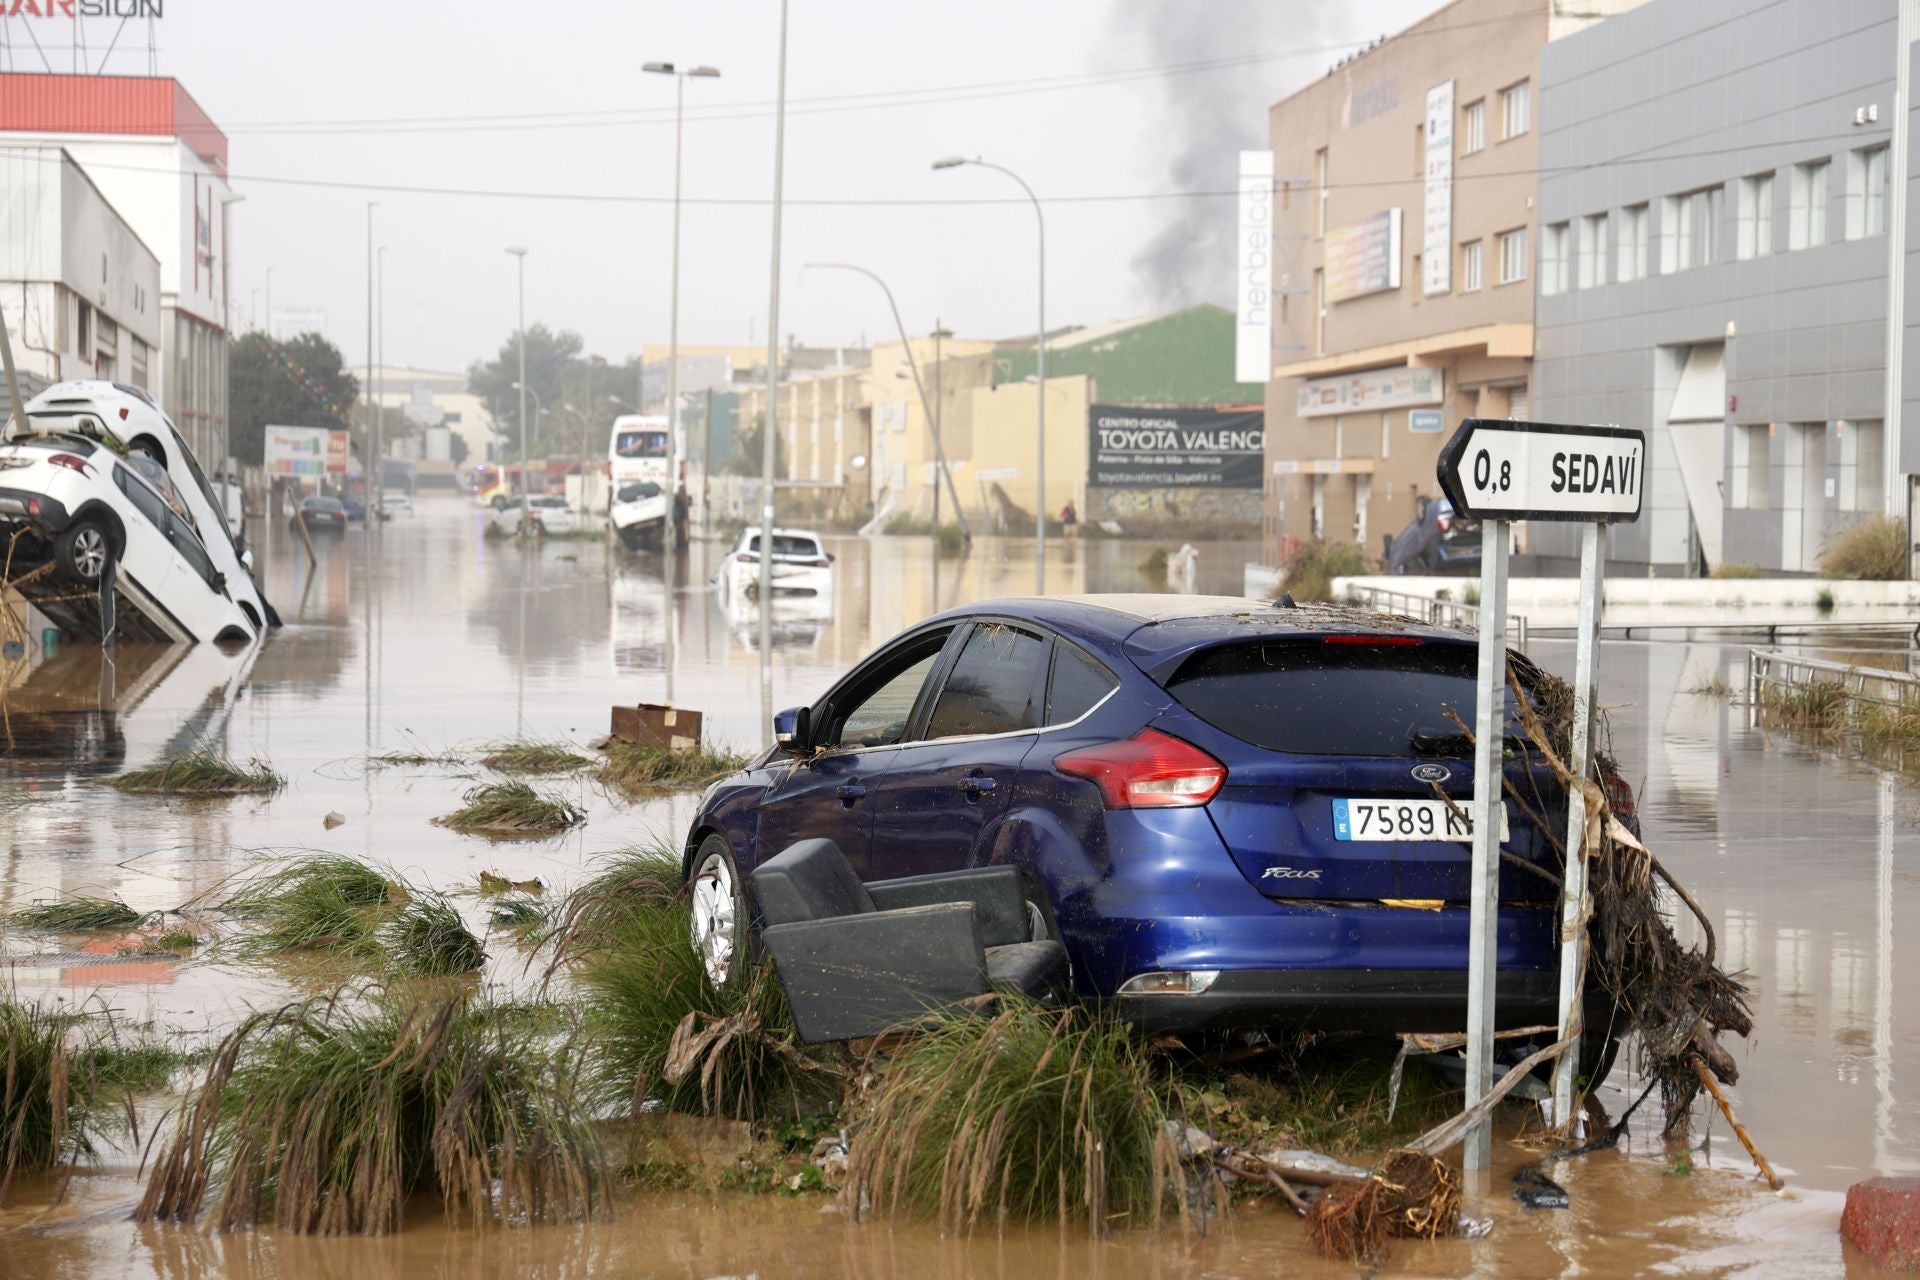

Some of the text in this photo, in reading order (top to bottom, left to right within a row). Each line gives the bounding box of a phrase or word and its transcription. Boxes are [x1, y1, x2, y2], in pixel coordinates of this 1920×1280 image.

[1099, 430, 1179, 449] TOYOTA
[1474, 447, 1637, 495] 0,8 SEDAVÍ
[1420, 767, 1442, 778] Ford
[1339, 824, 1347, 832] E
[1357, 806, 1434, 835] 7589
